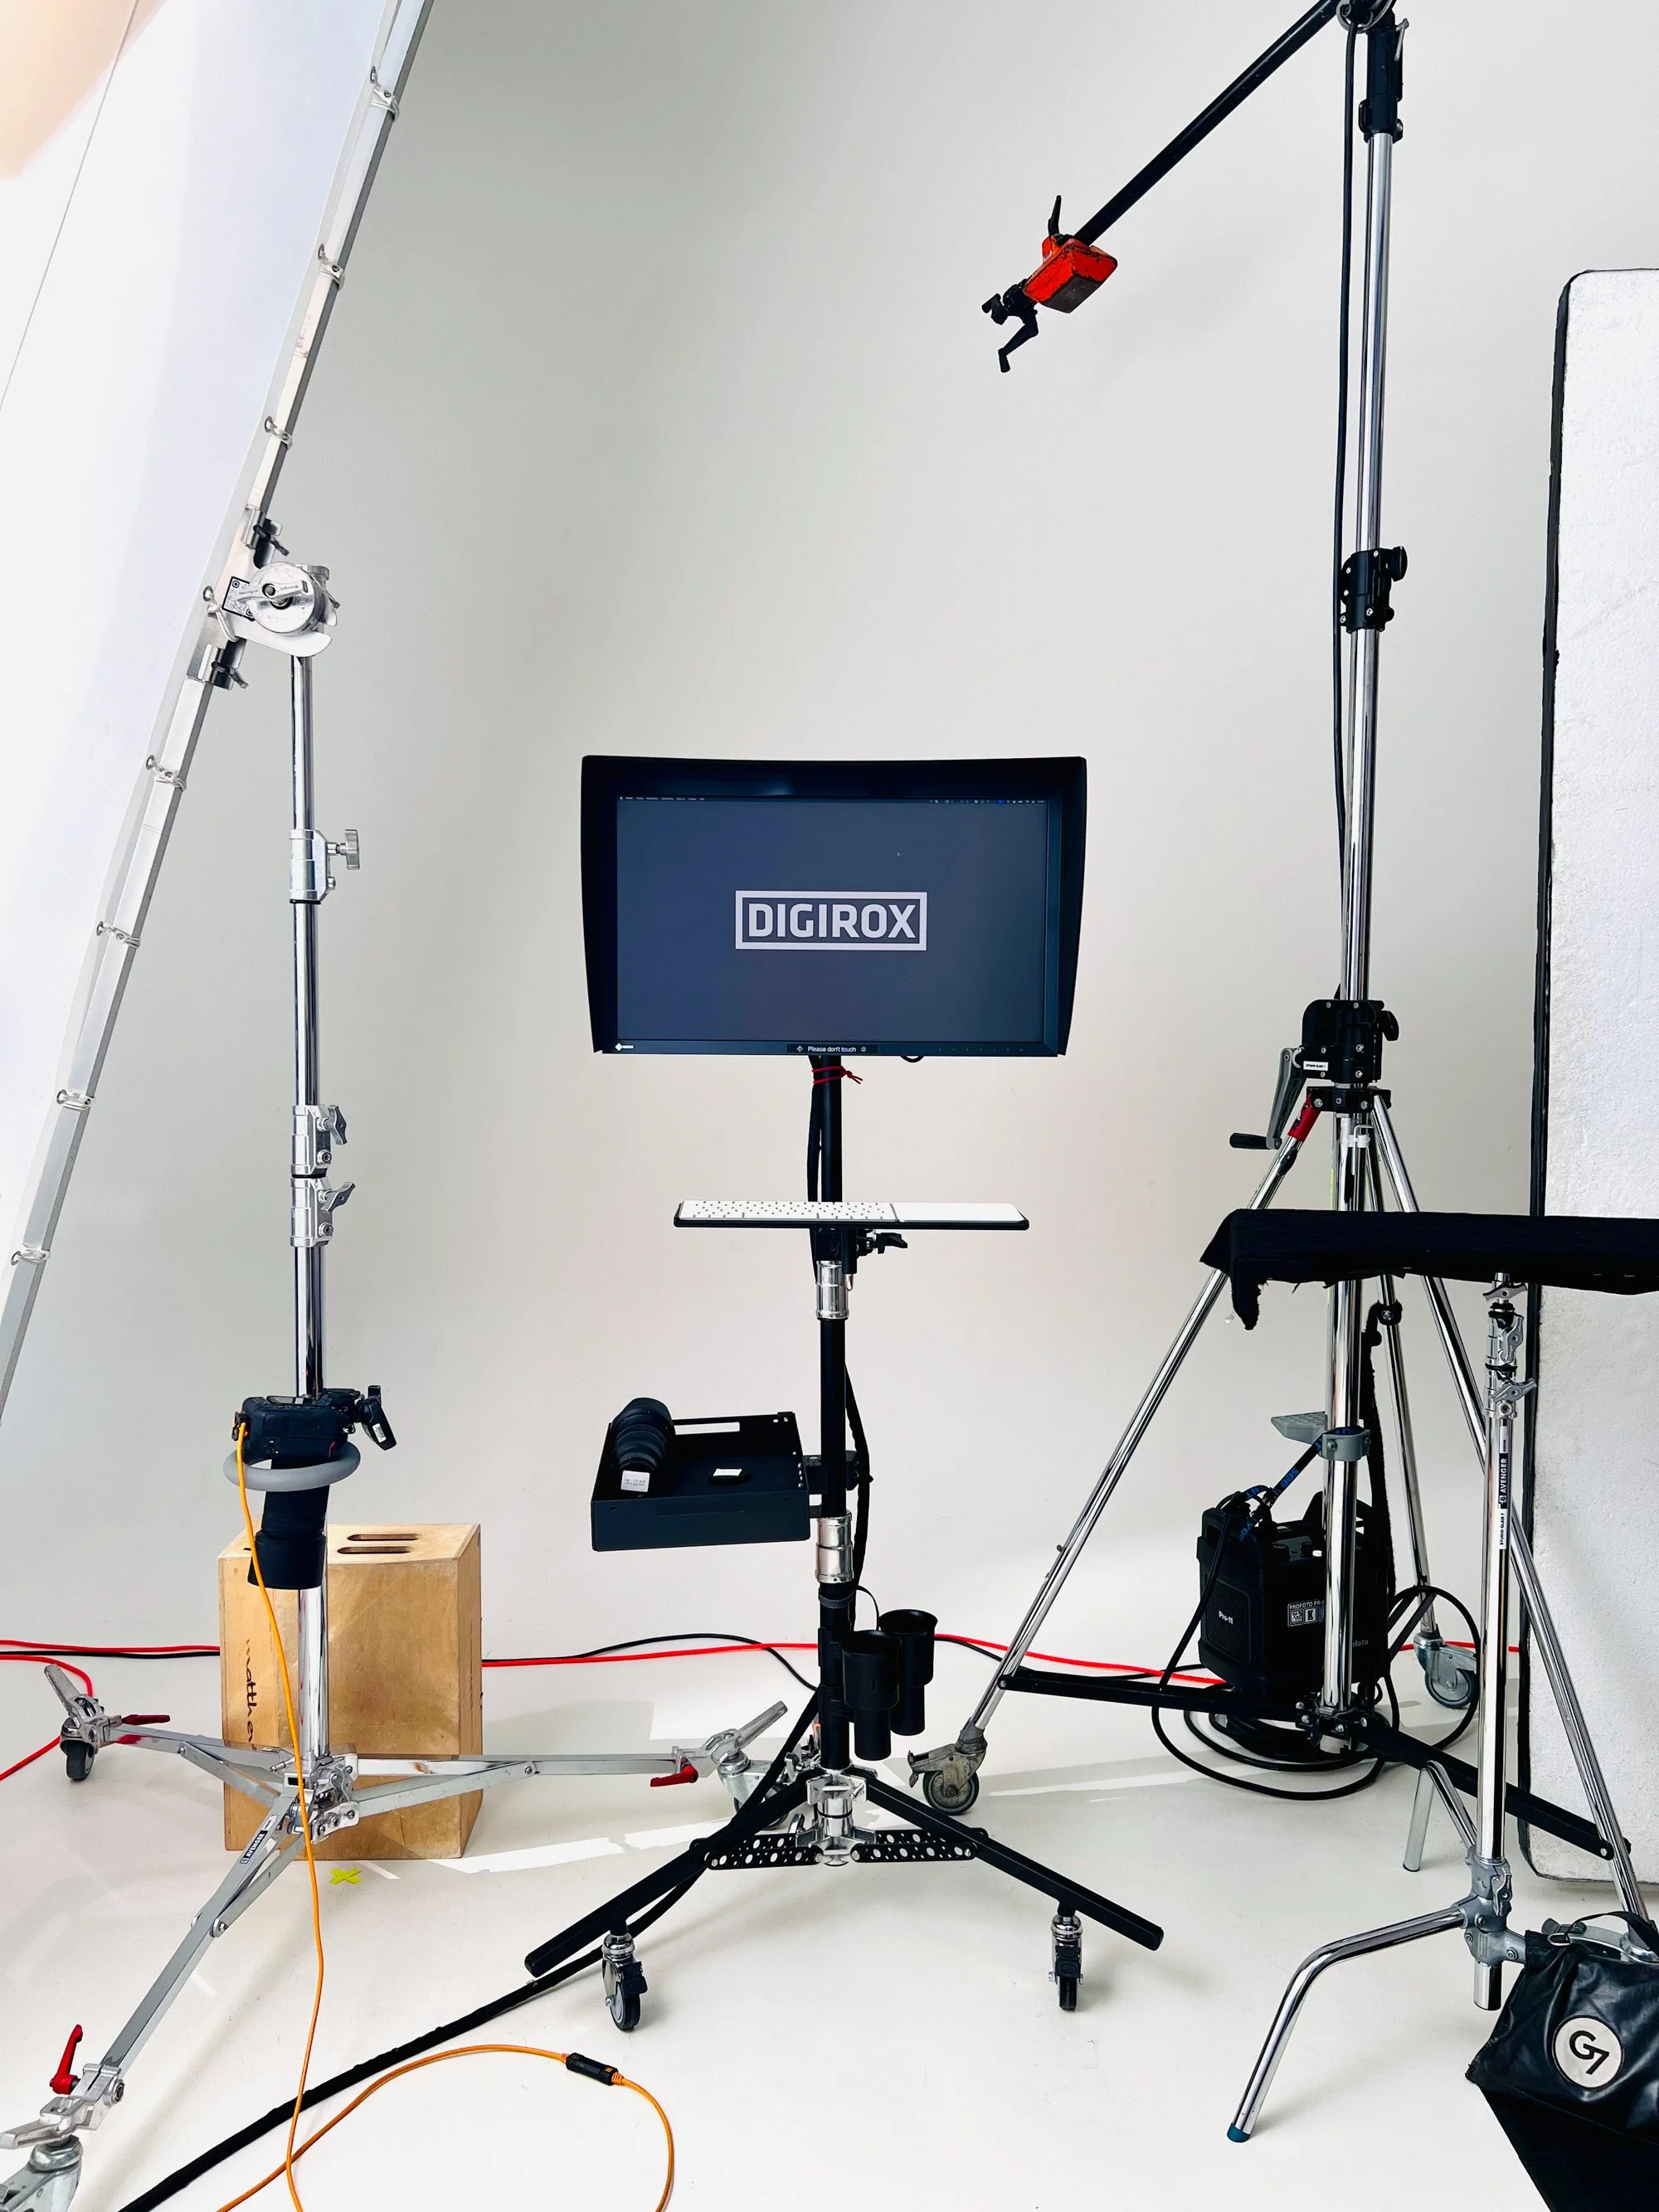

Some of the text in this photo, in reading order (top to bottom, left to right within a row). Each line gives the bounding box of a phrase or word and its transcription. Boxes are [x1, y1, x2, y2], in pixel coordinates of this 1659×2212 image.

[748, 903, 917, 939] DIGIROX
[1289, 1602, 1313, 1610] PROFOTO
[245, 1833, 266, 1858] AVENGER
[1569, 2030, 1610, 2075] G7
